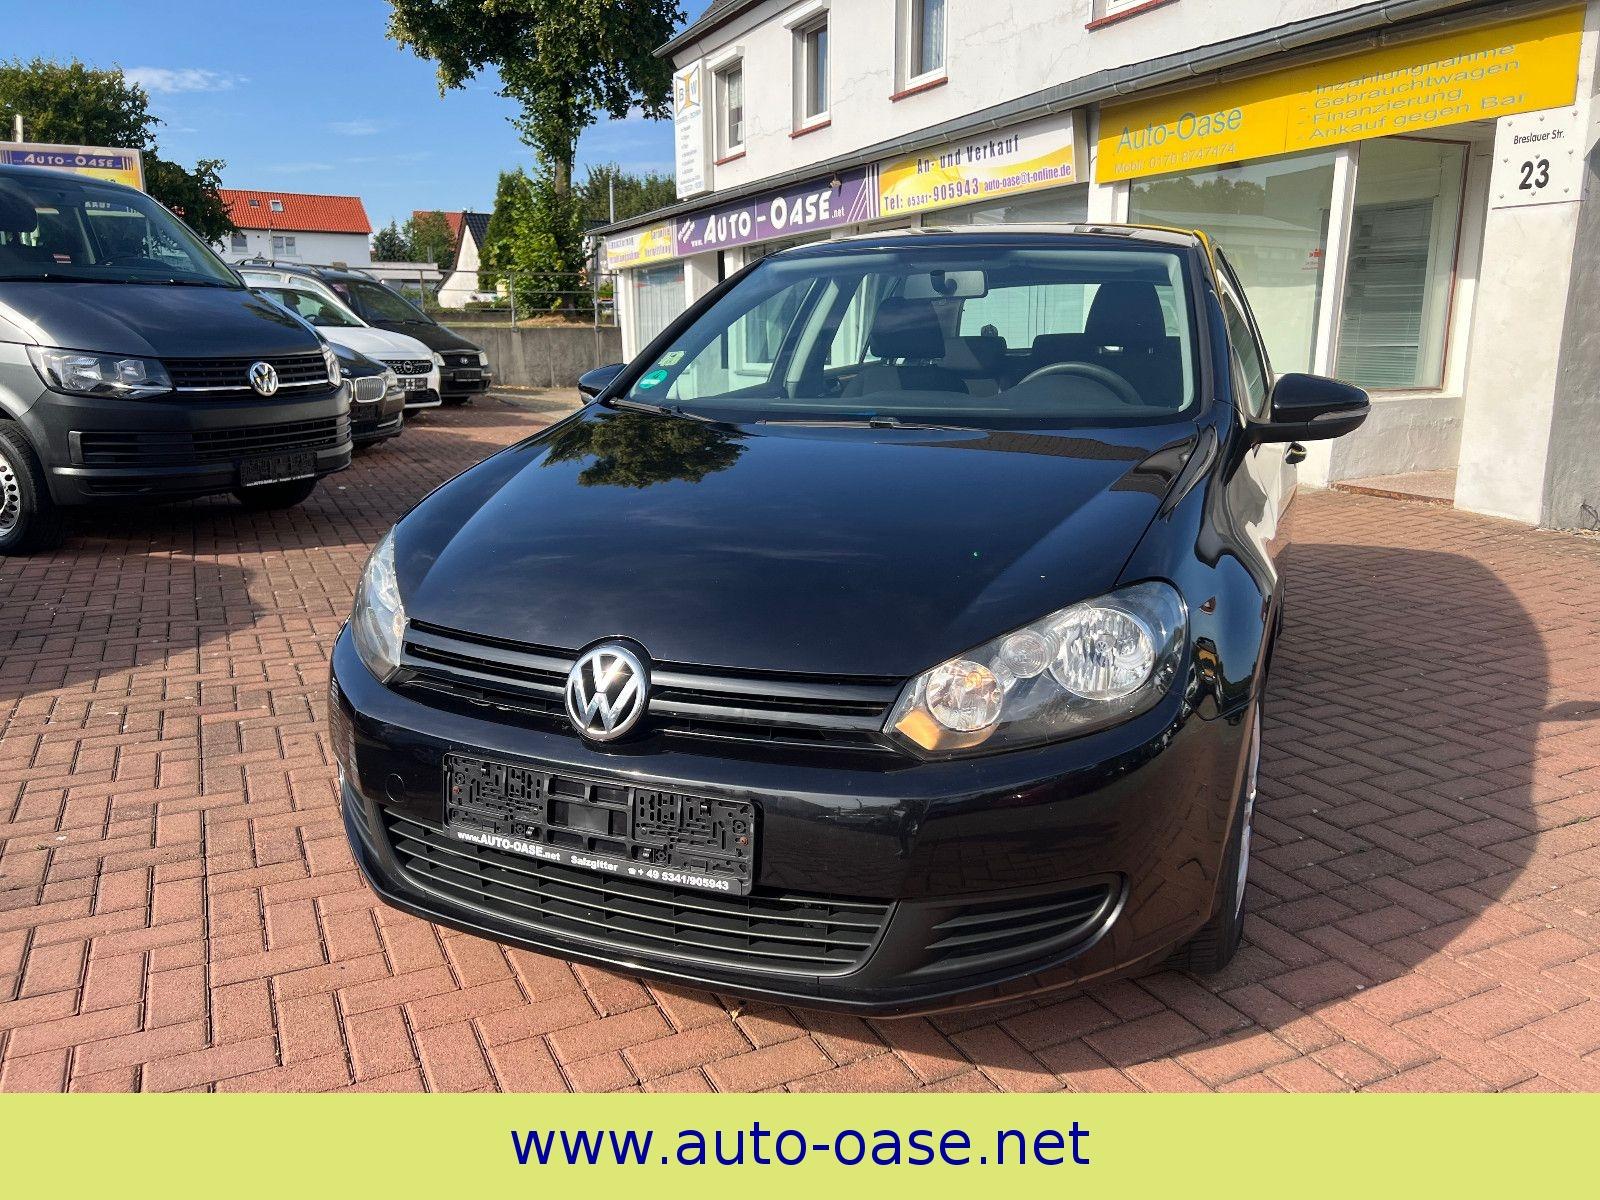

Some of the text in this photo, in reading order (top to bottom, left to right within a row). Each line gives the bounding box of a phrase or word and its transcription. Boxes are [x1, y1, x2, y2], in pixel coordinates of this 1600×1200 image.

[1312, 88, 1463, 125] Finanzierung
[1315, 61, 1520, 109] Gebrauchtwagen
[1116, 107, 1243, 154] Auto-Oase
[1309, 93, 1526, 141] Ankauf gegen Bar
[1513, 130, 1565, 145] Breslauer Str.
[917, 134, 1020, 174] An- und Verkauf
[1518, 159, 1550, 190] 23
[884, 194, 903, 211] Tel:
[984, 164, 1071, 191] auto-oase@t-online.de
[457, 831, 561, 861] www.AUTO-OASE.net
[570, 855, 619, 871] Salzgitter
[646, 868, 660, 879] 49
[661, 871, 729, 891] 5341/905943
